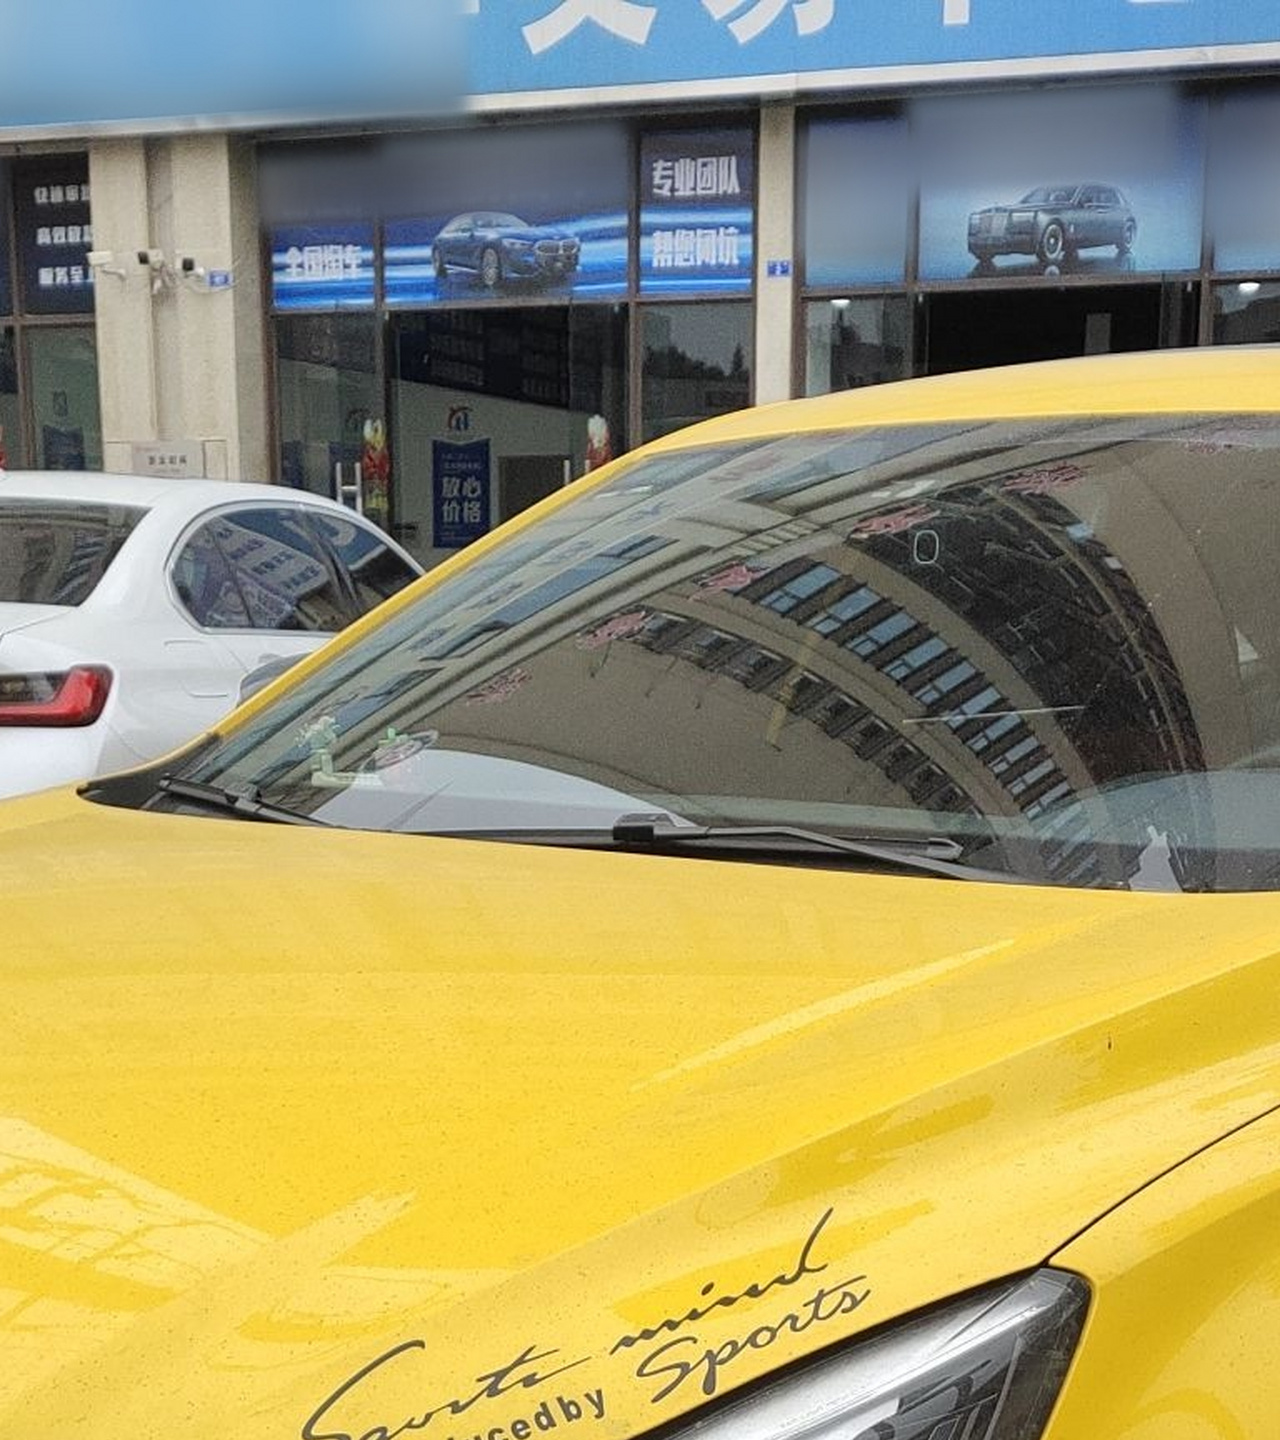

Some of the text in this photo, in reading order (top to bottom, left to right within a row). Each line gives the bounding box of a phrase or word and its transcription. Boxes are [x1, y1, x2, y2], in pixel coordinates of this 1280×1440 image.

[652, 156, 740, 196] 专业团队
[442, 475, 481, 498] 放心
[442, 501, 481, 523] 价格
[636, 1274, 871, 1404] Sports
